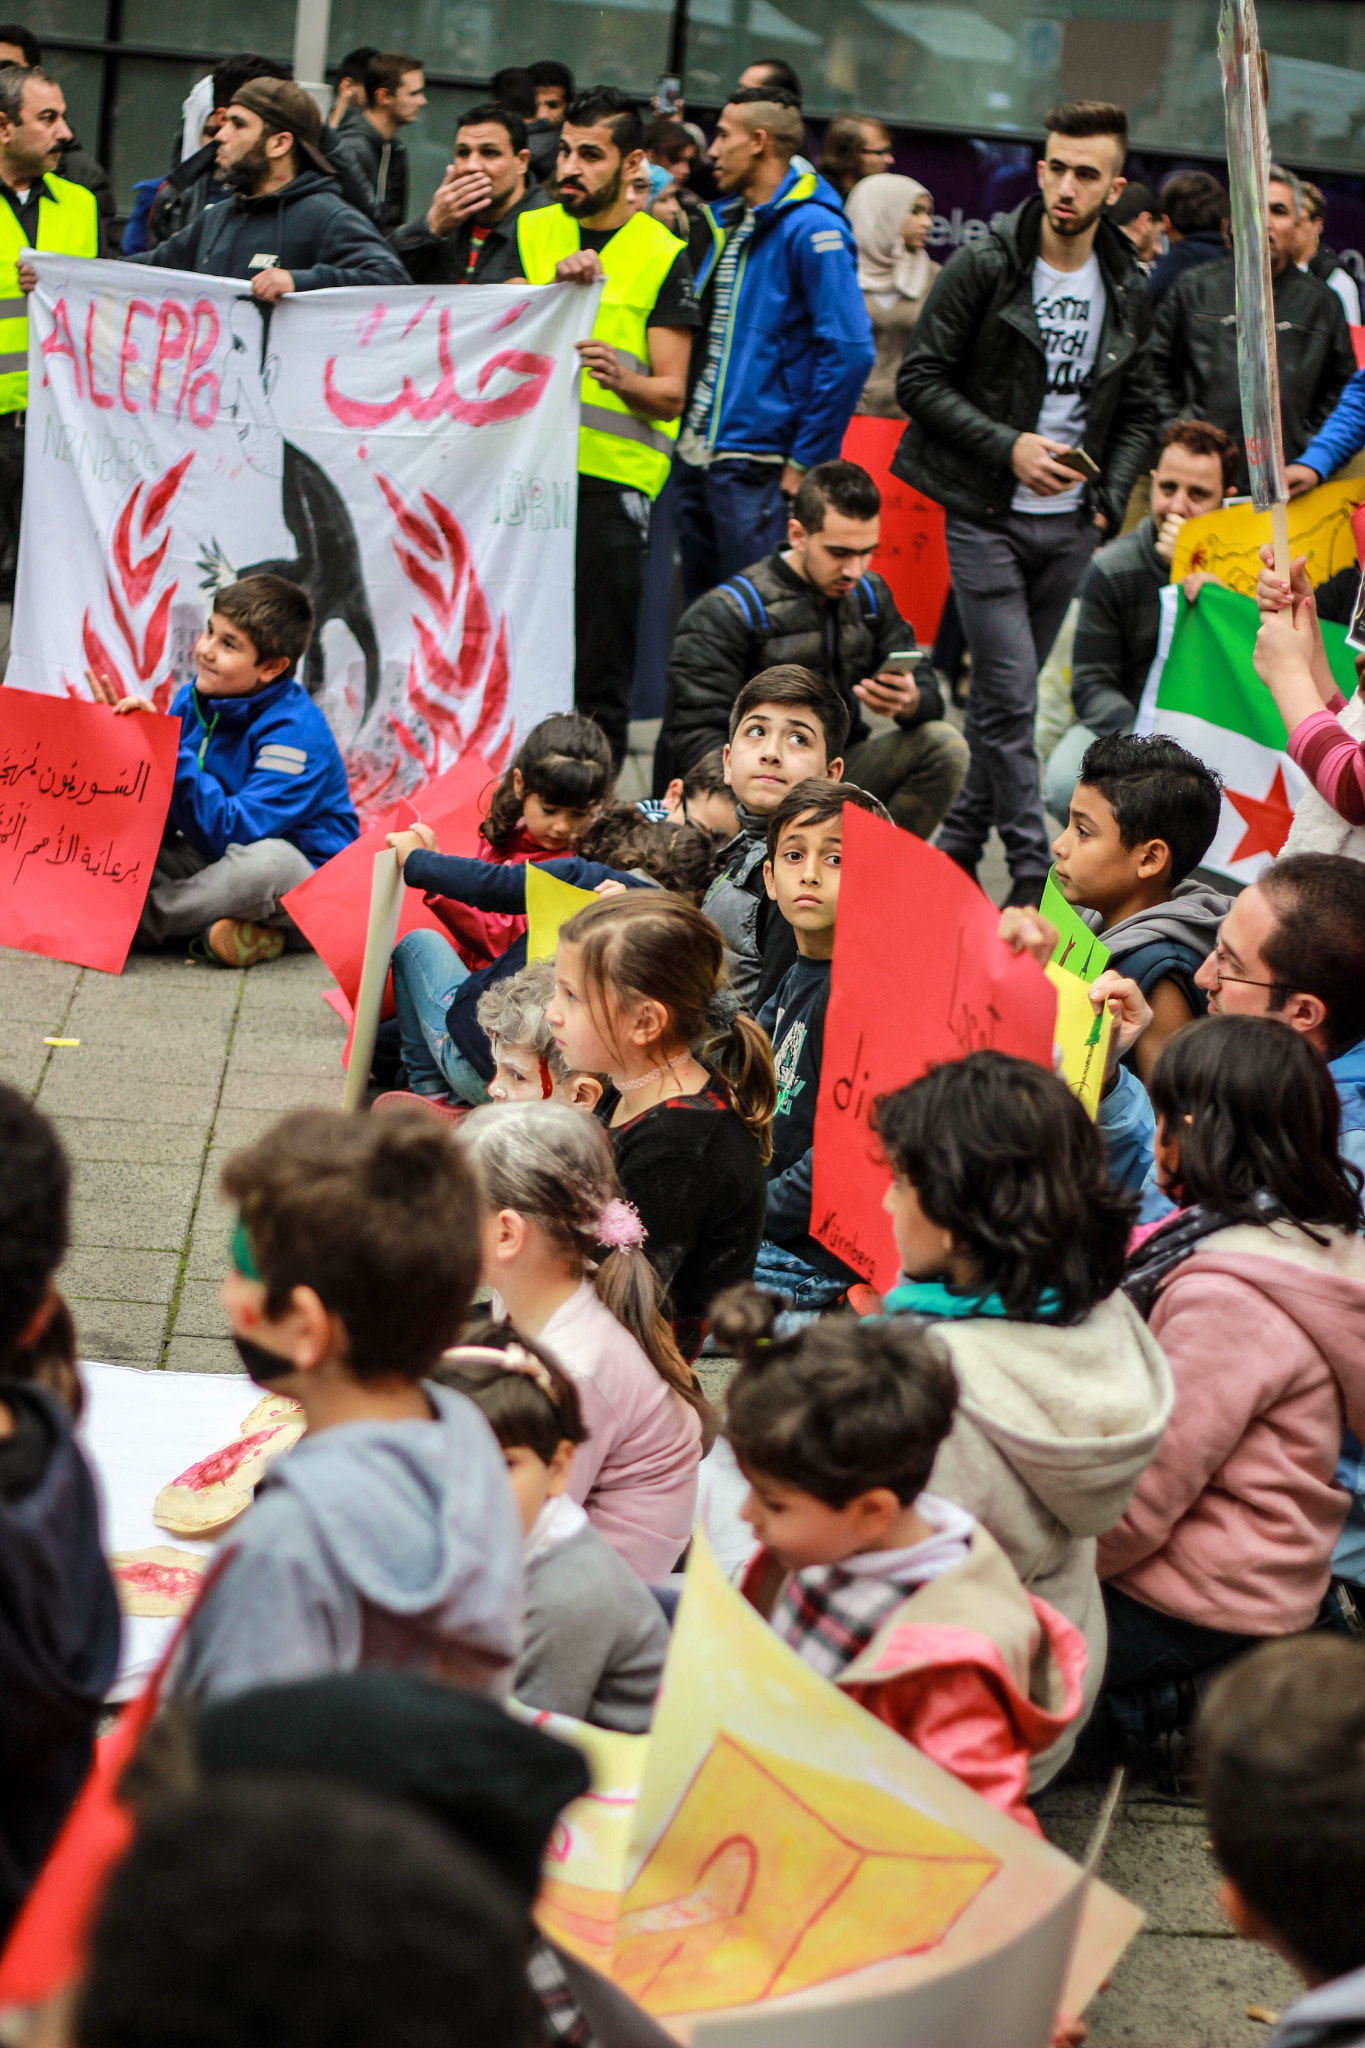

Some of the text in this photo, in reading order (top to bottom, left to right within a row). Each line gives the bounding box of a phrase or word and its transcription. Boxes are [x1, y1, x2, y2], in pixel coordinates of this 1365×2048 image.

[1034, 296, 1091, 321] GOTTA
[41, 297, 221, 430] ALEPPO
[818, 1209, 877, 1281] Nürnberg
